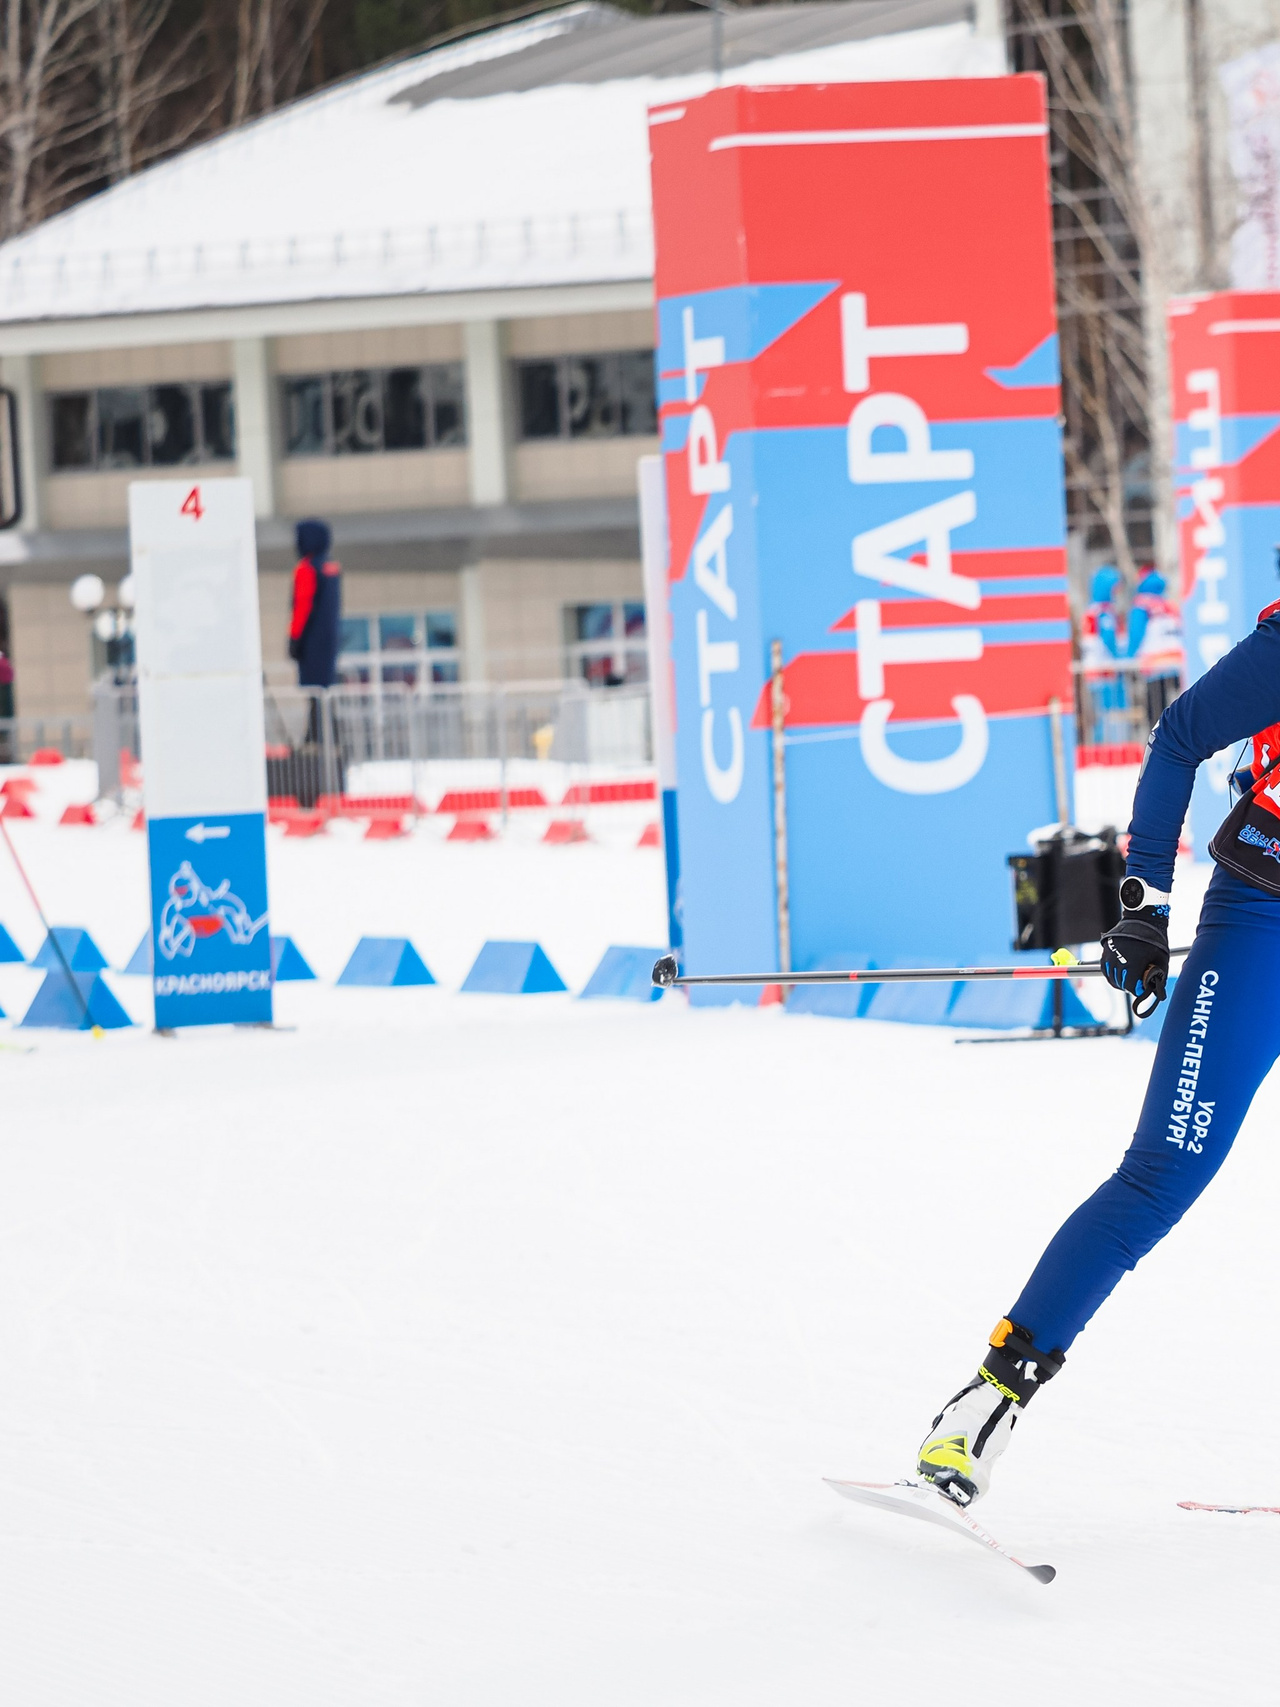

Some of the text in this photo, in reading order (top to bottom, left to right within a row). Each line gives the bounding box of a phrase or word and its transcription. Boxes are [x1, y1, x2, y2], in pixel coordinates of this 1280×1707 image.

[181, 486, 205, 521] 4
[684, 307, 744, 803] СТАРТ
[841, 293, 989, 794] СТАРТ
[155, 969, 271, 997] КРАСНОЯРСК
[1166, 970, 1219, 1149] САНКТ-ПЕТЕРБУРГ
[1187, 1100, 1216, 1155] УОР-2
